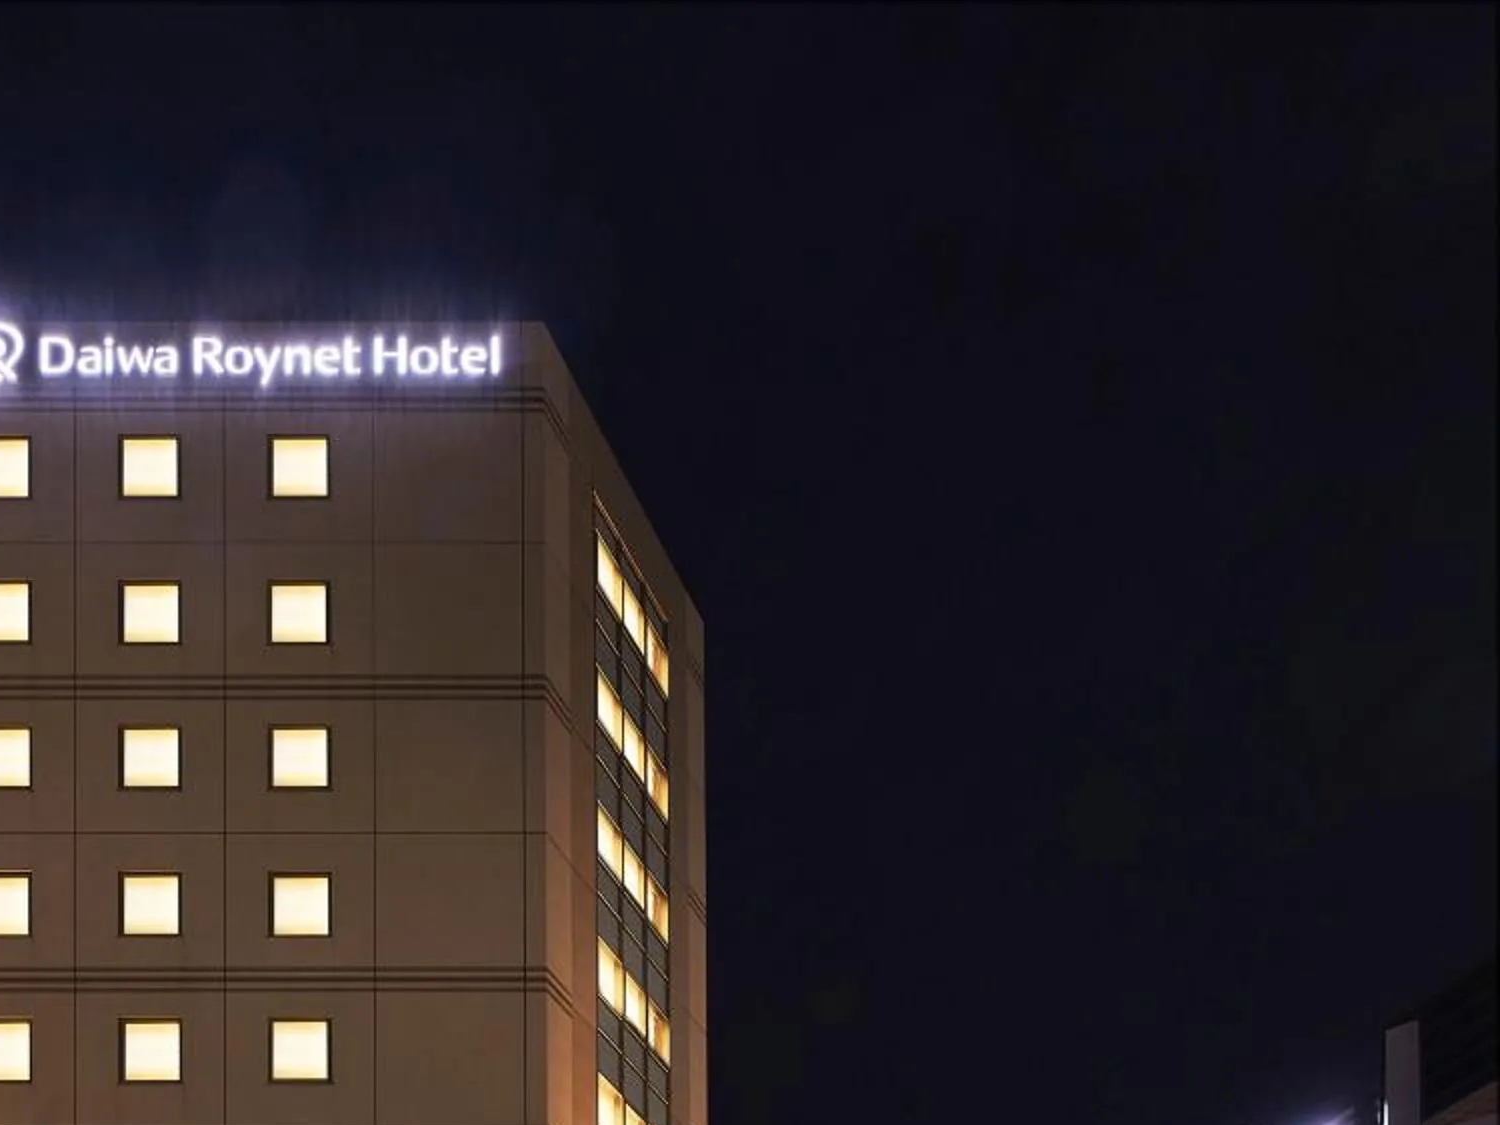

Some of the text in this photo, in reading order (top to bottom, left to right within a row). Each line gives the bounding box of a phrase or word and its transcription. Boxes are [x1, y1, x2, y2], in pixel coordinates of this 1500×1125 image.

[38, 335, 178, 376] Daiwa
[194, 335, 362, 387] Roynet
[373, 335, 503, 376] Hotel
